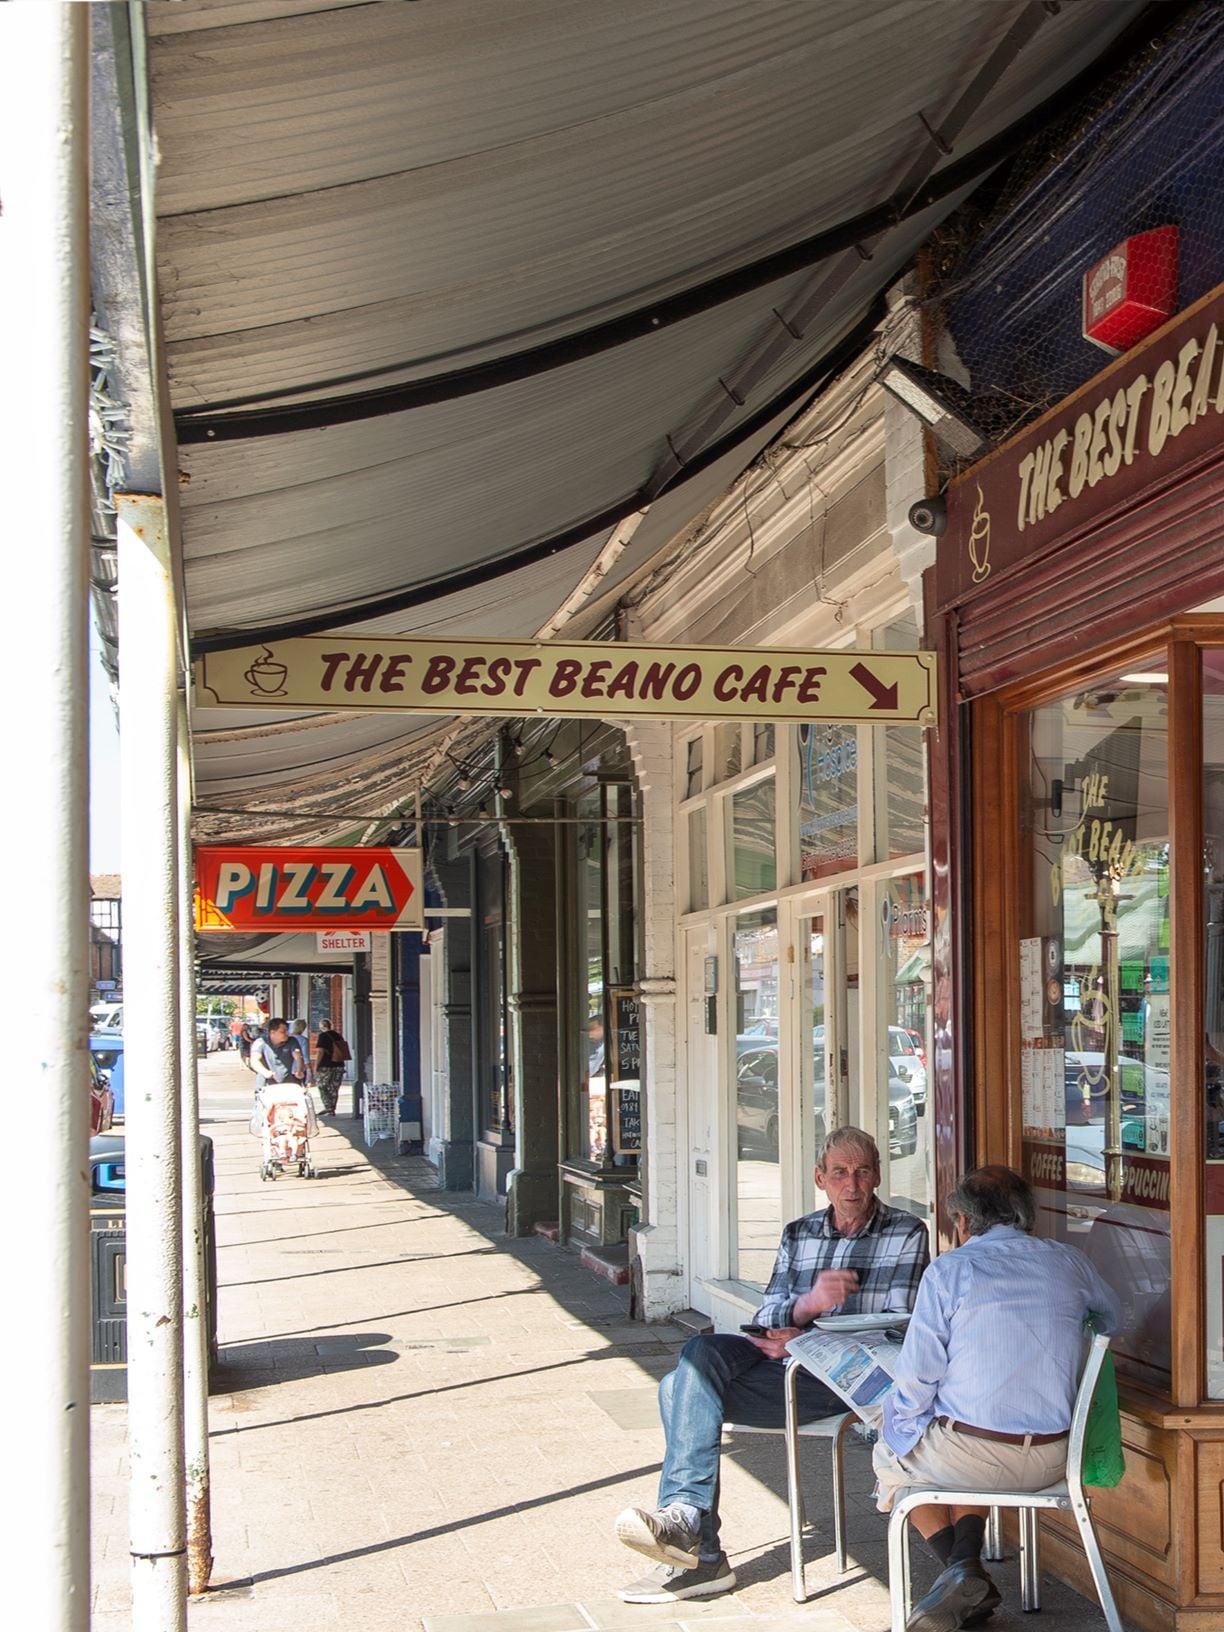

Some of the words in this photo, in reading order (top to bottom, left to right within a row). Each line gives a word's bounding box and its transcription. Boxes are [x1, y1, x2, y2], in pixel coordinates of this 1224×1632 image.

[1018, 428, 1068, 531] THE
[1069, 374, 1148, 499] BEST
[319, 652, 412, 693] THE
[421, 656, 539, 697] BEST
[548, 659, 703, 701] BEANO
[713, 664, 826, 703] CAFE
[1081, 772, 1109, 809] THE
[215, 862, 396, 915] PIZZA
[321, 938, 366, 949] SHELTER
[620, 1030, 639, 1041] TUE
[620, 1042, 640, 1054] SATU
[1031, 1151, 1063, 1182] COFFEE
